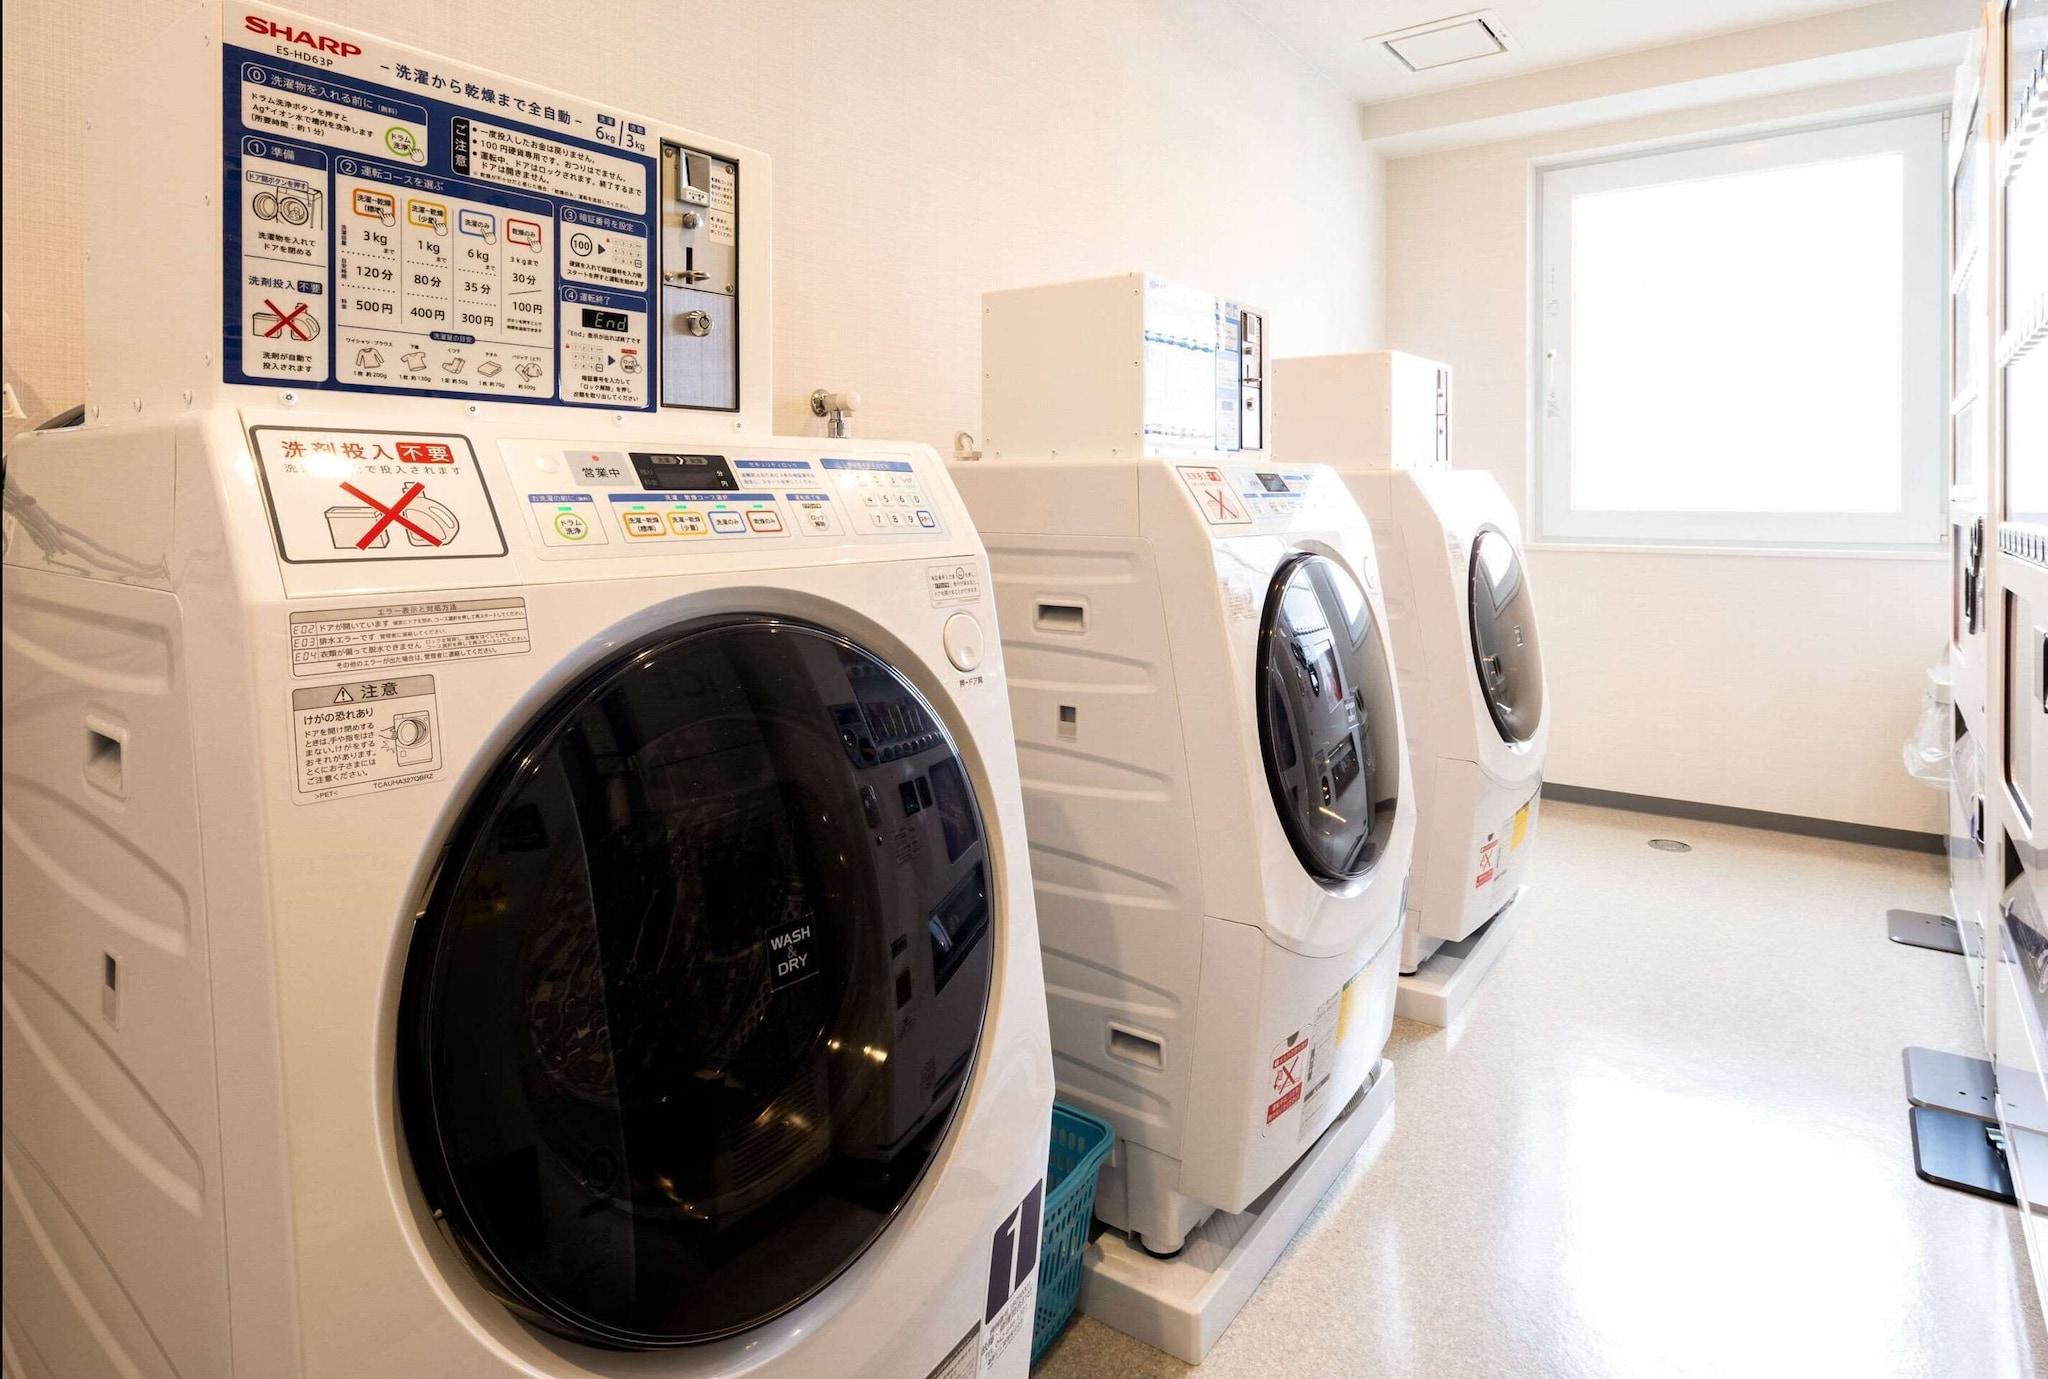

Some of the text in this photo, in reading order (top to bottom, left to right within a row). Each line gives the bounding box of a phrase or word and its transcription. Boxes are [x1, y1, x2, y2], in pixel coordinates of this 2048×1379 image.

[245, 16, 362, 57] SHARP
[276, 45, 334, 67] ES-HD63P
[271, 74, 373, 110] 洗濯物を入れる前に
[251, 92, 348, 122] ドラム洗浄ボタンを押すと
[596, 126, 615, 144] 6kg
[626, 134, 645, 152] 3kg
[270, 145, 295, 161] 準備
[455, 124, 468, 167] ご注意
[361, 165, 445, 191] 運転コースを選ぶ
[481, 161, 551, 185] ドアは開きません。
[579, 213, 635, 232] 暗証番号を設定
[258, 231, 316, 247] 洗濯物を入れて
[573, 240, 590, 251] 100
[248, 276, 295, 291] 洗剤投入
[580, 294, 611, 306] 運転終了
[594, 312, 627, 331] End
[262, 351, 313, 363] 洗剤が自動で
[262, 362, 313, 374] 投入されます
[402, 446, 451, 463] 不要
[581, 467, 621, 479] 営業中
[560, 519, 582, 527] ドラム
[875, 515, 881, 524] 7
[892, 515, 899, 523] 8
[907, 515, 914, 523] 9
[377, 604, 457, 616] エラー表示と対処方法
[319, 620, 389, 633] ドアが開いています
[319, 634, 375, 646] 排水エラーです
[361, 682, 399, 700] 注意
[303, 708, 374, 726] けがの恐れあり
[304, 722, 375, 738] ドアを開け閉めする
[306, 750, 377, 767] おそれがあります。
[306, 758, 376, 776] とくにお子さまには
[307, 770, 369, 786] ご注意ください。
[770, 925, 811, 951] WASH
[787, 945, 798, 959] &
[778, 952, 808, 977] DRY
[1006, 1201, 1024, 1300] 1
